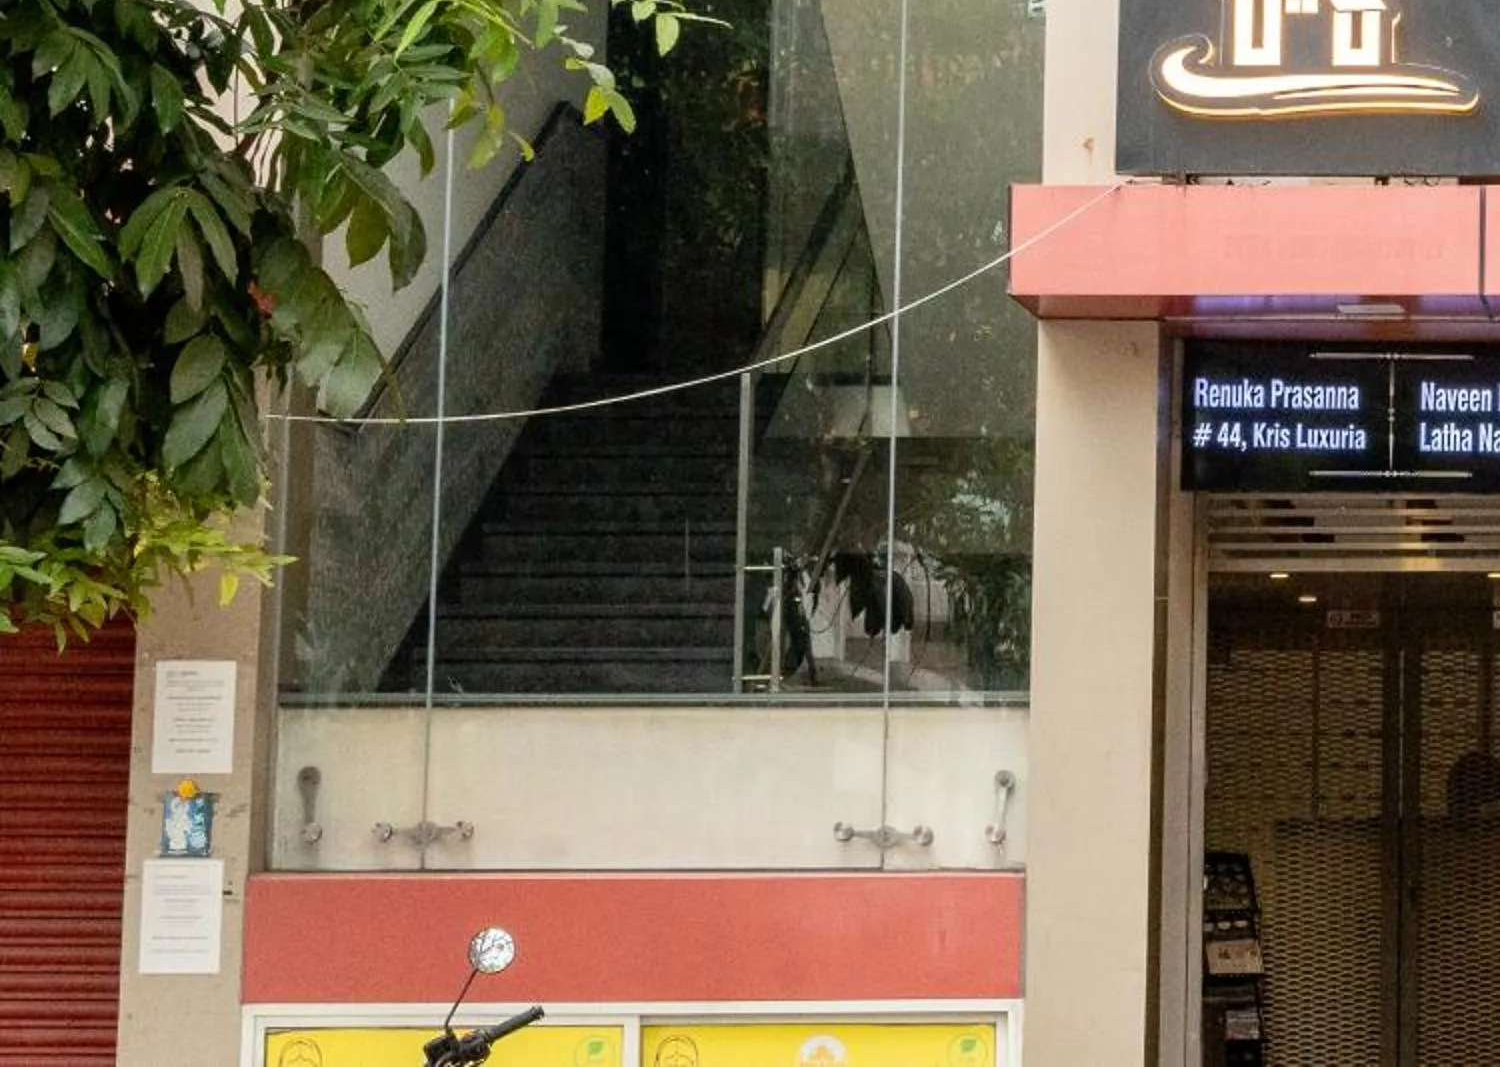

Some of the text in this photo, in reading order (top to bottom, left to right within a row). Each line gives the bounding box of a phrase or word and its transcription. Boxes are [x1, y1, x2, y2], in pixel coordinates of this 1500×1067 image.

[1195, 377, 1360, 411] Renuka Prasanna
[1420, 381, 1492, 413] Naveen
[1217, 422, 1247, 452] 44,
[1253, 422, 1291, 449] Kris
[1296, 422, 1366, 451] Luxuria
[1420, 422, 1473, 453] Latha
